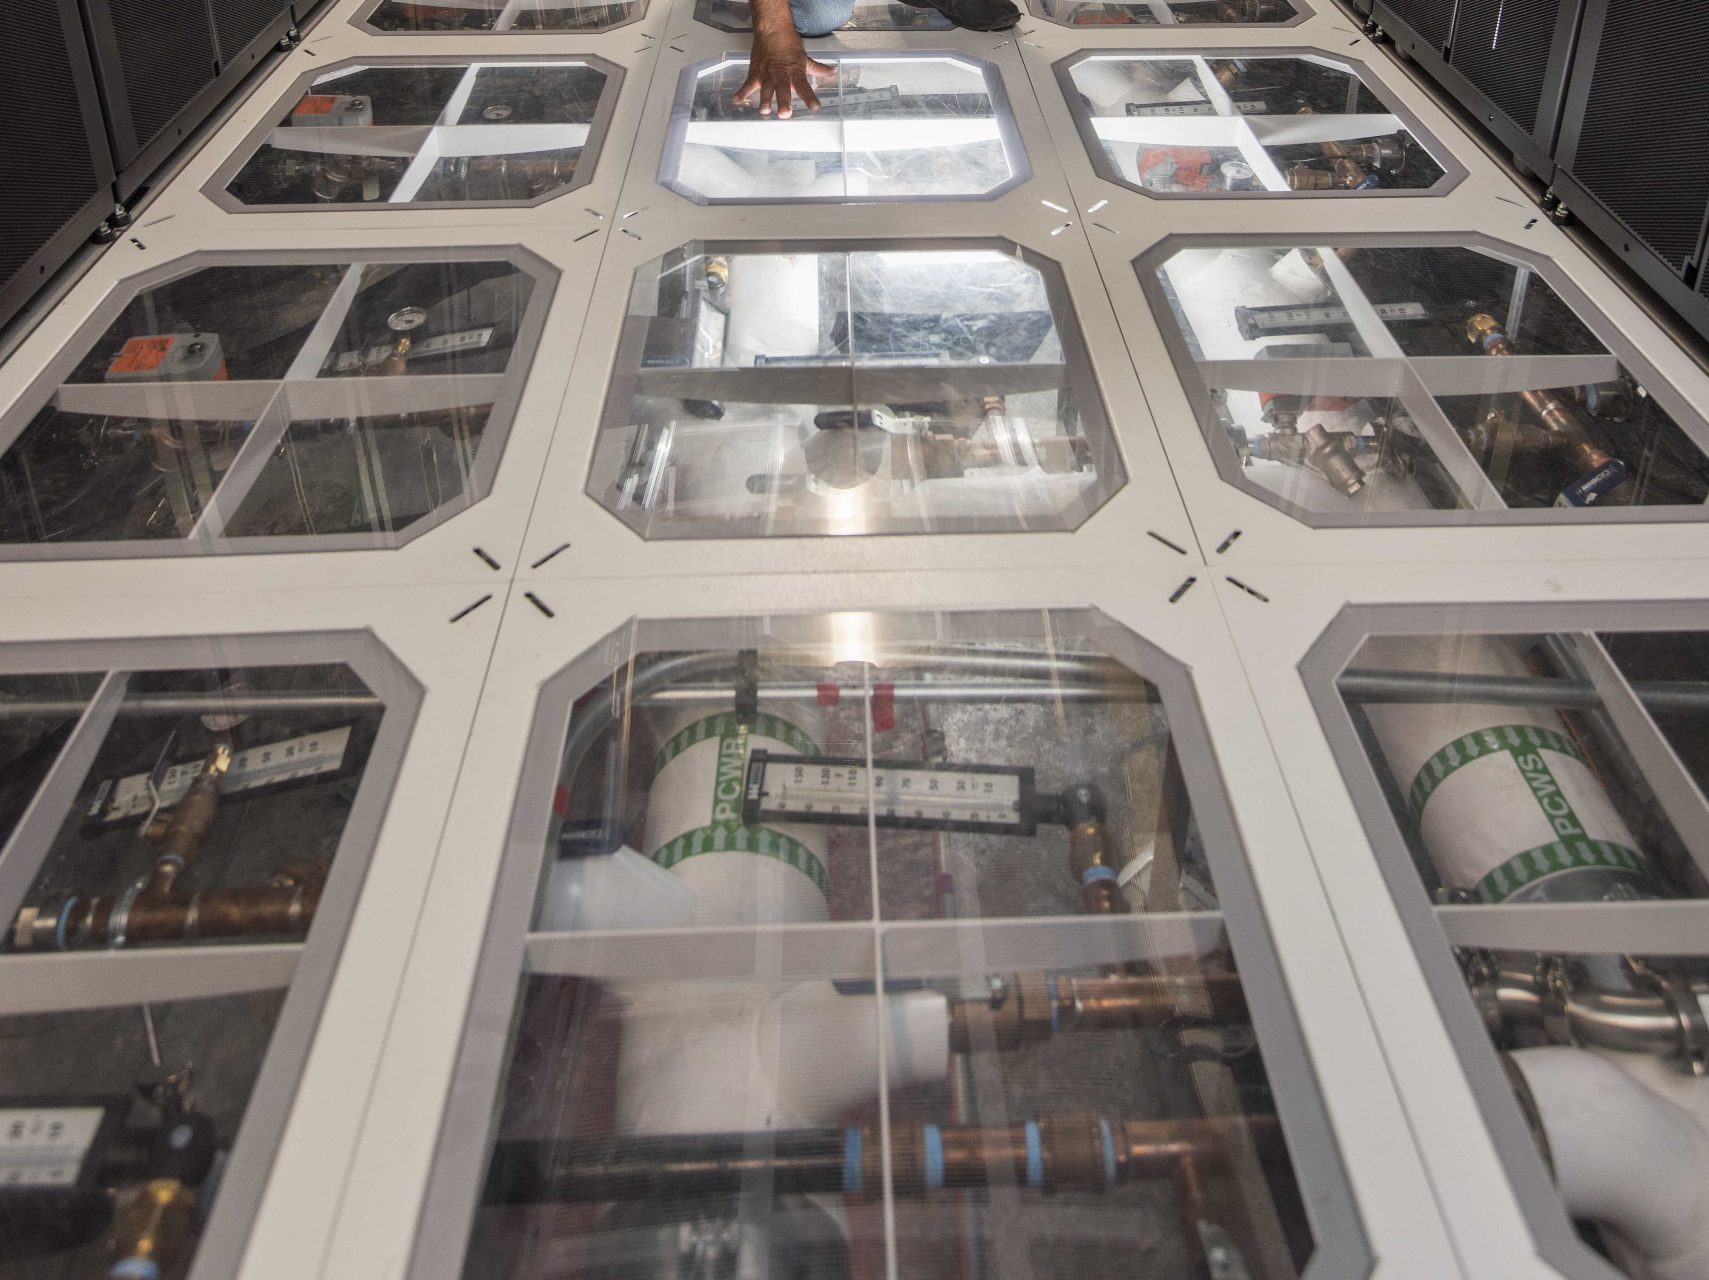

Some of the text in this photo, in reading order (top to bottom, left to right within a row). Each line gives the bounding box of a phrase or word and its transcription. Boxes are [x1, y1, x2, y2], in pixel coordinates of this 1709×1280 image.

[714, 736, 743, 821] PCWR
[794, 766, 804, 784] 150
[820, 767, 831, 785] 130
[848, 768, 858, 787] 110
[902, 776, 911, 788] 70
[929, 777, 938, 790] 50
[956, 779, 966, 792] 30
[983, 781, 993, 794] 10
[1517, 753, 1583, 835] PCWS
